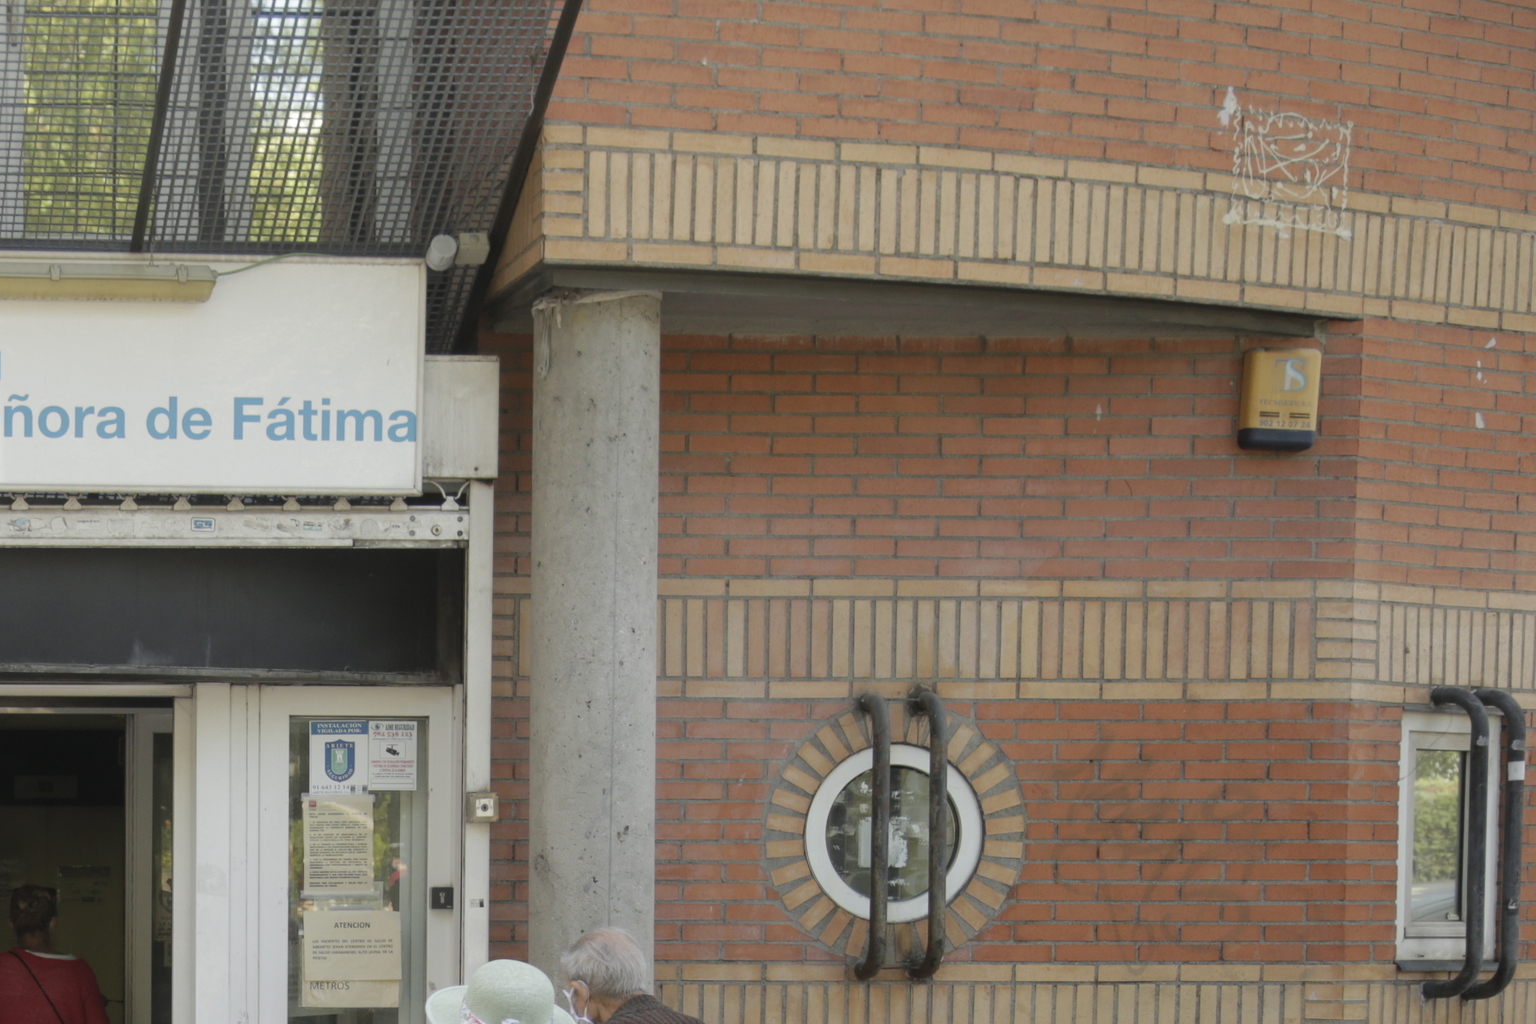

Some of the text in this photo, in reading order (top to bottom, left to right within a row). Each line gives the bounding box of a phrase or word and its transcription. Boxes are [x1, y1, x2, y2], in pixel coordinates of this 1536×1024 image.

[146, 396, 213, 441] de
[233, 397, 417, 443] Fátima
[1259, 419, 1273, 427] 902
[1277, 420, 1286, 428] 12
[1288, 420, 1298, 428] 07
[327, 768, 354, 781] SEGURIDAD
[309, 981, 350, 990] METROS
